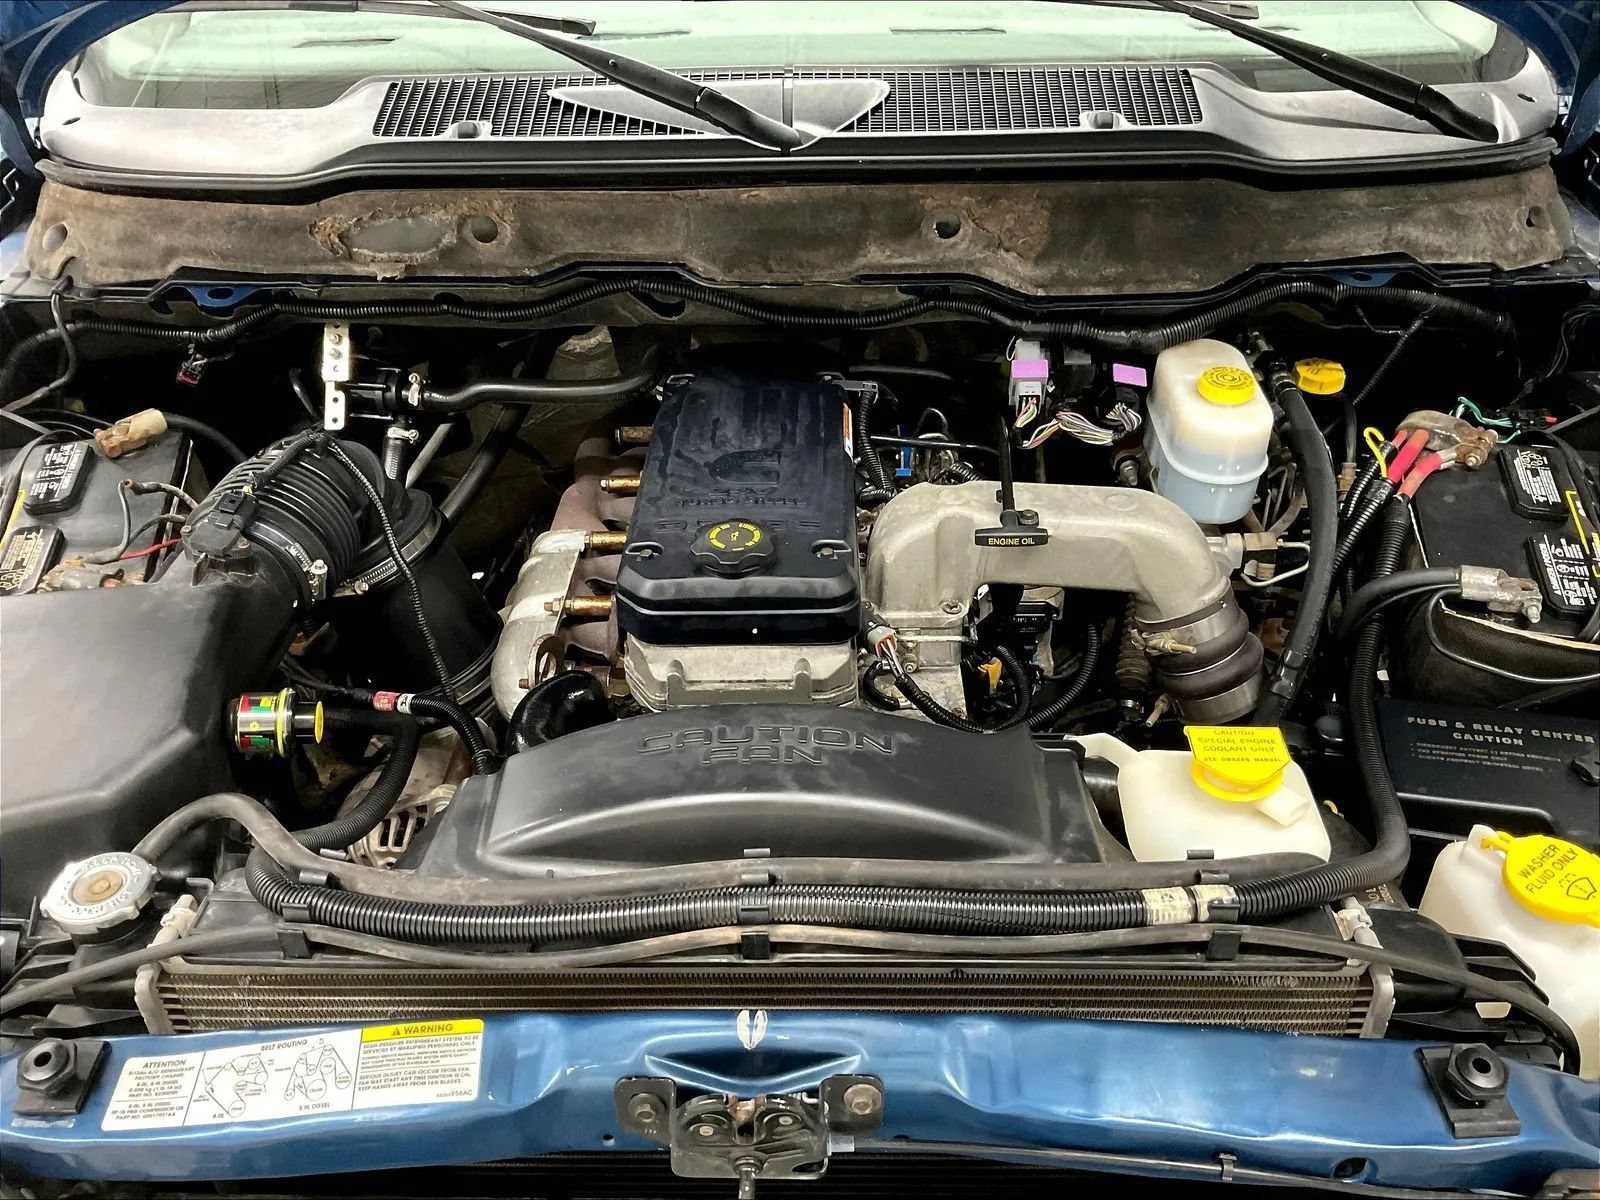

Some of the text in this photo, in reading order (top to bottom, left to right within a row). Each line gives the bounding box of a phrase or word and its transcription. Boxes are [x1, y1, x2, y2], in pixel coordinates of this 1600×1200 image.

[988, 537, 1036, 546] ENGINE OIL
[1407, 716, 1596, 744] FUSE & RELAY CENTER
[637, 724, 895, 754] CAUTION
[1452, 732, 1524, 746] CAUTION
[702, 744, 823, 765] FAN
[1519, 843, 1560, 879] WASHER
[1525, 848, 1578, 895] FLUID ONLY
[403, 1023, 454, 1035] WARNING
[277, 1039, 308, 1050] ROUTING
[142, 1059, 187, 1069] ATTENTION
